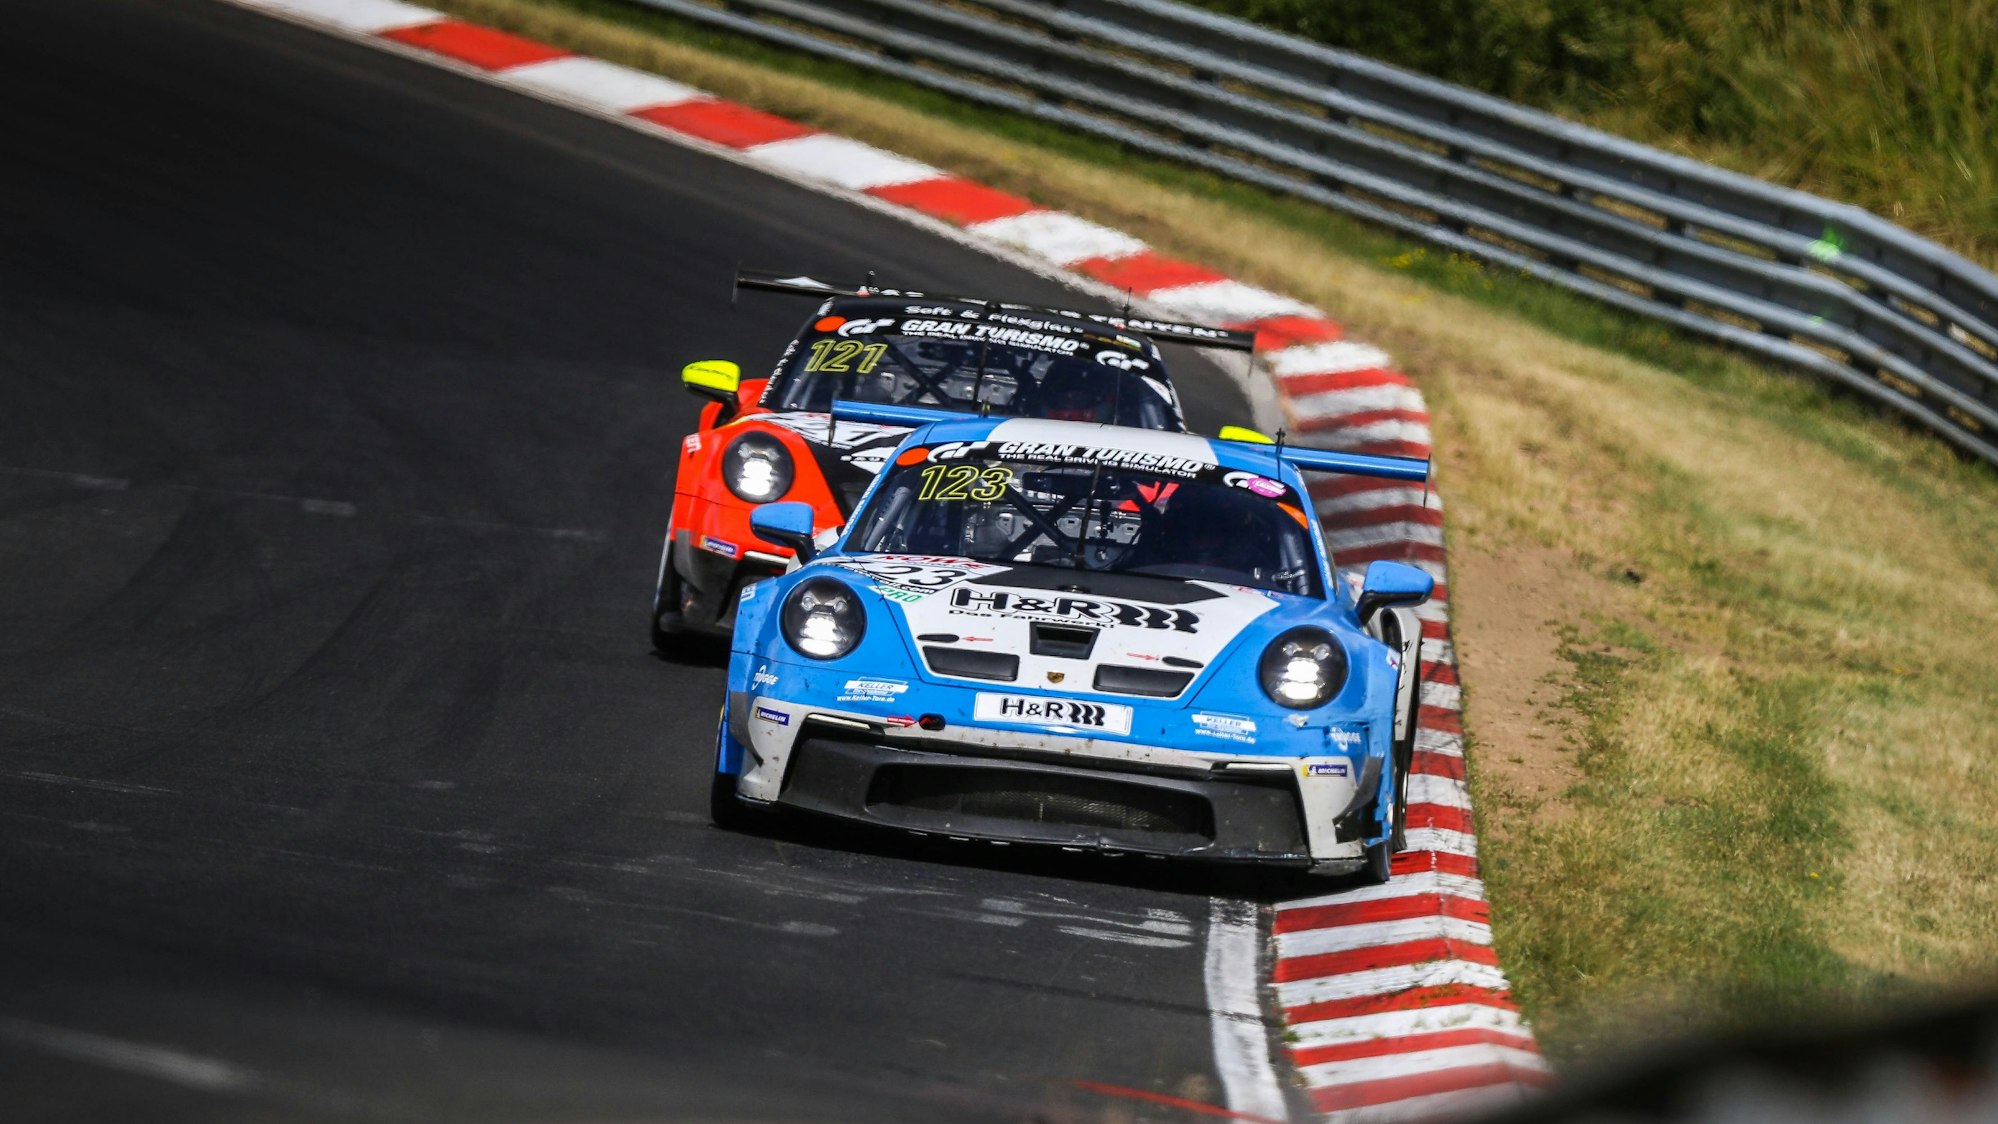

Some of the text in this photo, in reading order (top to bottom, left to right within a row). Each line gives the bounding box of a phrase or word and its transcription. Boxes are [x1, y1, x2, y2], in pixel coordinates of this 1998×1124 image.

[960, 309, 980, 320] &
[901, 319, 972, 335] GRAN
[804, 338, 888, 375] 121
[998, 440, 1077, 456] GRAN
[1028, 454, 1062, 462] REAL
[1119, 461, 1197, 479] SIMULATOR
[918, 464, 1014, 501] 123
[949, 609, 992, 617] Das
[857, 682, 894, 690] KELLER
[1001, 697, 1064, 719] H&R
